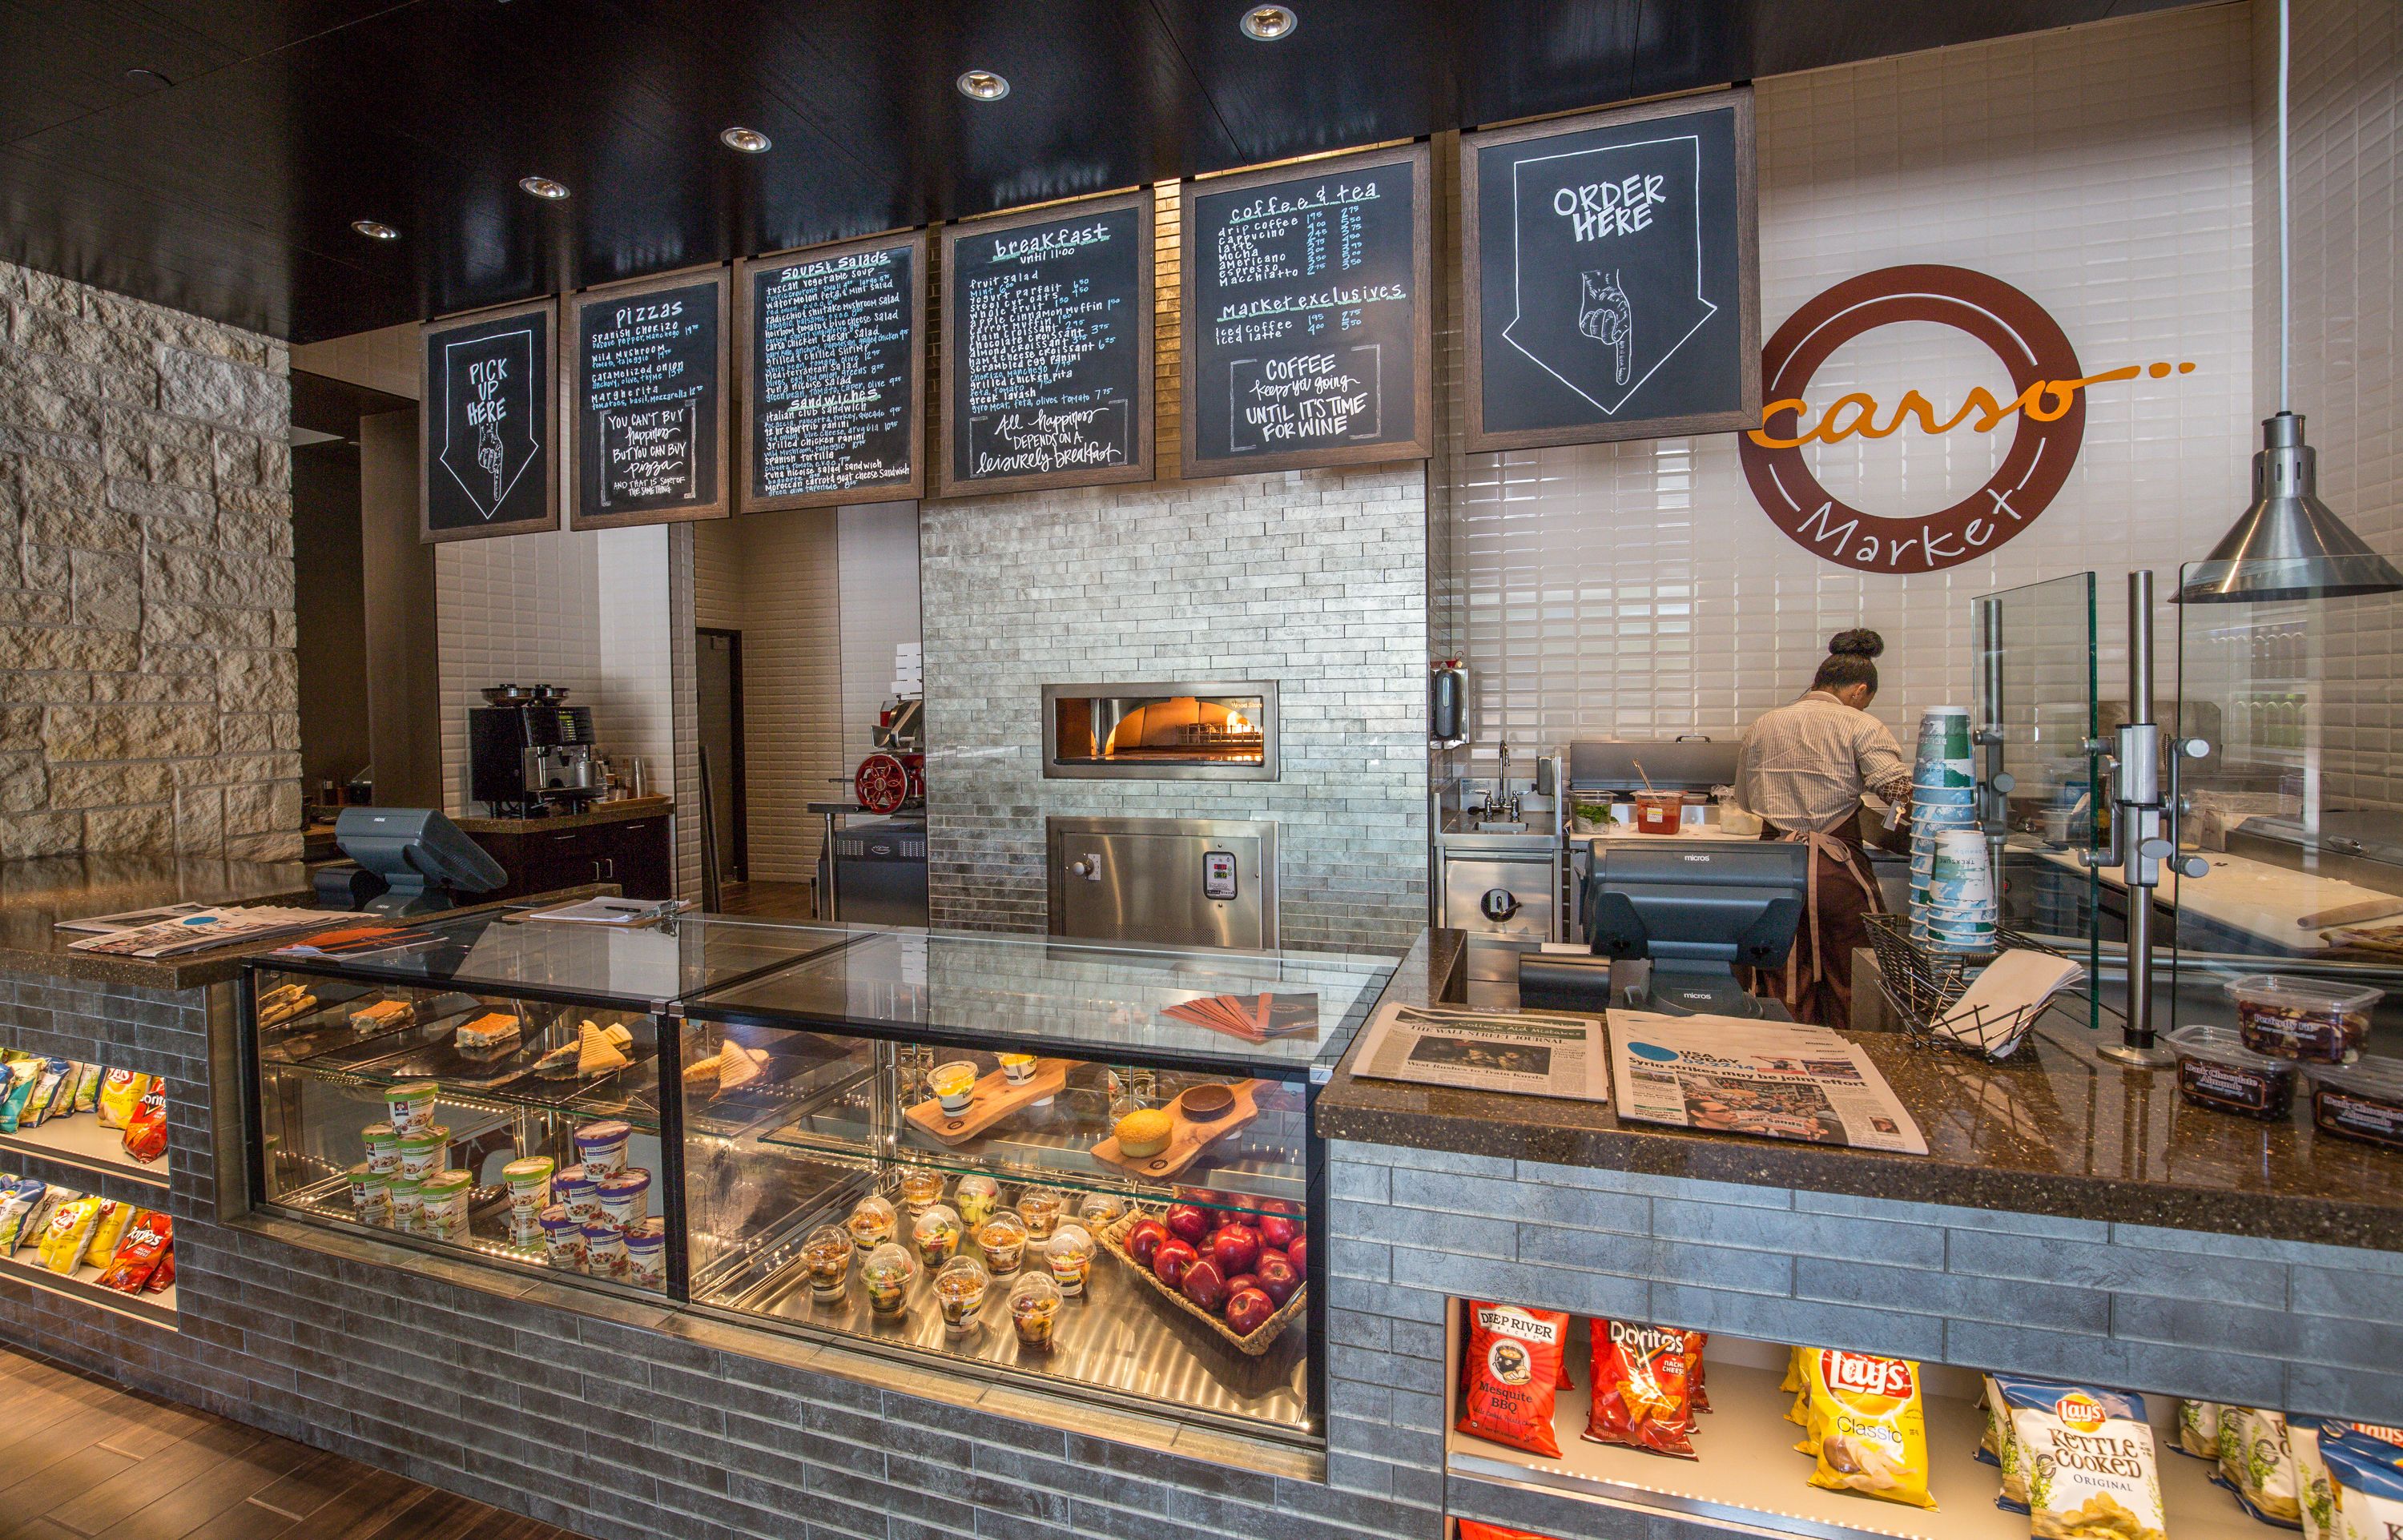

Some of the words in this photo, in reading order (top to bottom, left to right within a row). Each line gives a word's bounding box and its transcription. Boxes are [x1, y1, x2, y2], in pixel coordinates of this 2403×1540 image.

[1337, 183, 1376, 203] tea
[1553, 173, 1666, 215] ORDER
[1218, 223, 1250, 238] drip
[1254, 216, 1298, 230] coffee
[1572, 203, 1653, 242] HERE
[995, 223, 1108, 257] breakfast
[1218, 229, 1285, 245] cappucino
[1020, 249, 1045, 263] until
[1051, 247, 1074, 259] 11:00
[1218, 241, 1254, 254] latte
[969, 276, 1000, 289] fruit
[1004, 271, 1038, 283] salad
[1219, 263, 1278, 279] espresso
[766, 281, 799, 295] tuscan
[970, 292, 1009, 304] yogurt
[1016, 283, 1061, 297] parfait
[1298, 284, 1402, 308] exclusives
[970, 301, 1004, 312] steel
[1004, 298, 1022, 308] cut
[1030, 292, 1057, 303] oats
[970, 308, 1006, 320] whole
[1011, 304, 1045, 314] fruit
[970, 316, 1005, 328] apple
[970, 324, 1007, 336] carrot
[1215, 324, 1242, 337] iced
[1246, 320, 1293, 333] coffee
[970, 333, 999, 344] plain
[1004, 324, 1058, 338] croissant
[1216, 333, 1242, 345] iced
[1250, 329, 1282, 341] latte
[969, 337, 1023, 352] chocolate
[970, 347, 1005, 357] almond
[1000, 351, 1035, 360] cheese
[1028, 357, 1045, 368] egg
[1050, 352, 1081, 364] panini
[470, 358, 508, 384] PICK
[1266, 354, 1336, 381] COFFEE
[970, 377, 1006, 391] grilled
[1010, 372, 1049, 385] chicken
[1053, 368, 1073, 384] pita
[1249, 380, 1291, 401] keeps
[1314, 375, 1360, 395] going
[478, 380, 498, 400] UP
[970, 393, 998, 405] greek
[1004, 388, 1036, 400] lavash
[467, 399, 507, 425] HERE
[767, 410, 795, 422] italian
[798, 408, 817, 416] club
[822, 402, 866, 413] sandwich
[1246, 403, 1294, 424] UNTIL
[1299, 399, 1326, 418] IT'S
[1325, 392, 1368, 417] TIME
[1746, 364, 2140, 449] carso
[609, 416, 627, 429] YOU
[632, 412, 658, 426] CAN'T
[662, 408, 684, 424] BUY
[994, 413, 1024, 440] All
[1028, 408, 1109, 432] happiness
[1262, 423, 1296, 442] FOR
[1298, 415, 1348, 438] WINE
[625, 427, 680, 446] happiness
[767, 438, 797, 450] grilled
[1013, 433, 1057, 450] DEPENDS
[1059, 432, 1071, 443] ON
[1073, 432, 1084, 444] A
[613, 447, 633, 463] BUT
[634, 446, 647, 459] YOU
[650, 444, 665, 456] CAN
[668, 442, 686, 456] BUY
[801, 452, 834, 461] tortilla
[976, 447, 1053, 472] leisurely
[1054, 441, 1121, 468] breakfast
[623, 460, 683, 478] pizza
[614, 481, 627, 490] AND
[629, 480, 648, 488] THAT
[628, 489, 641, 497] THE
[1797, 488, 2021, 566] Market
[1685, 854, 1709, 862] micros
[1684, 991, 1711, 1000] micros
[1411, 1024, 1433, 1033] THE
[1436, 1028, 1463, 1036] WALL
[1465, 1031, 1511, 1040] STREET
[1512, 1035, 1564, 1045] JOURNAL
[1457, 1021, 1503, 1031] College
[1531, 1027, 1581, 1036] Mistakes
[1683, 1055, 1739, 1064] TODAY
[1628, 1057, 1664, 1068] Syria
[1668, 1065, 1718, 1075] strikes
[1722, 1071, 1753, 1080] may
[1781, 1076, 1818, 1084] joint
[1821, 1079, 1868, 1088] effort
[2184, 1063, 2208, 1077] Dark
[1480, 1313, 1509, 1325] DEEP
[1511, 1318, 1552, 1339] RIVER
[1610, 1321, 1683, 1353] Doritos
[1830, 1349, 1906, 1395] Lay's
[1479, 1381, 1532, 1403] Mesquite
[1491, 1397, 1517, 1414] BBQ
[2061, 1401, 2102, 1422] Lay's
[1837, 1416, 1903, 1444] Classic
[2047, 1428, 2138, 1458] KETTLE
[2055, 1448, 2143, 1478] COOKED
[2073, 1474, 2133, 1492] ORIGINAL
